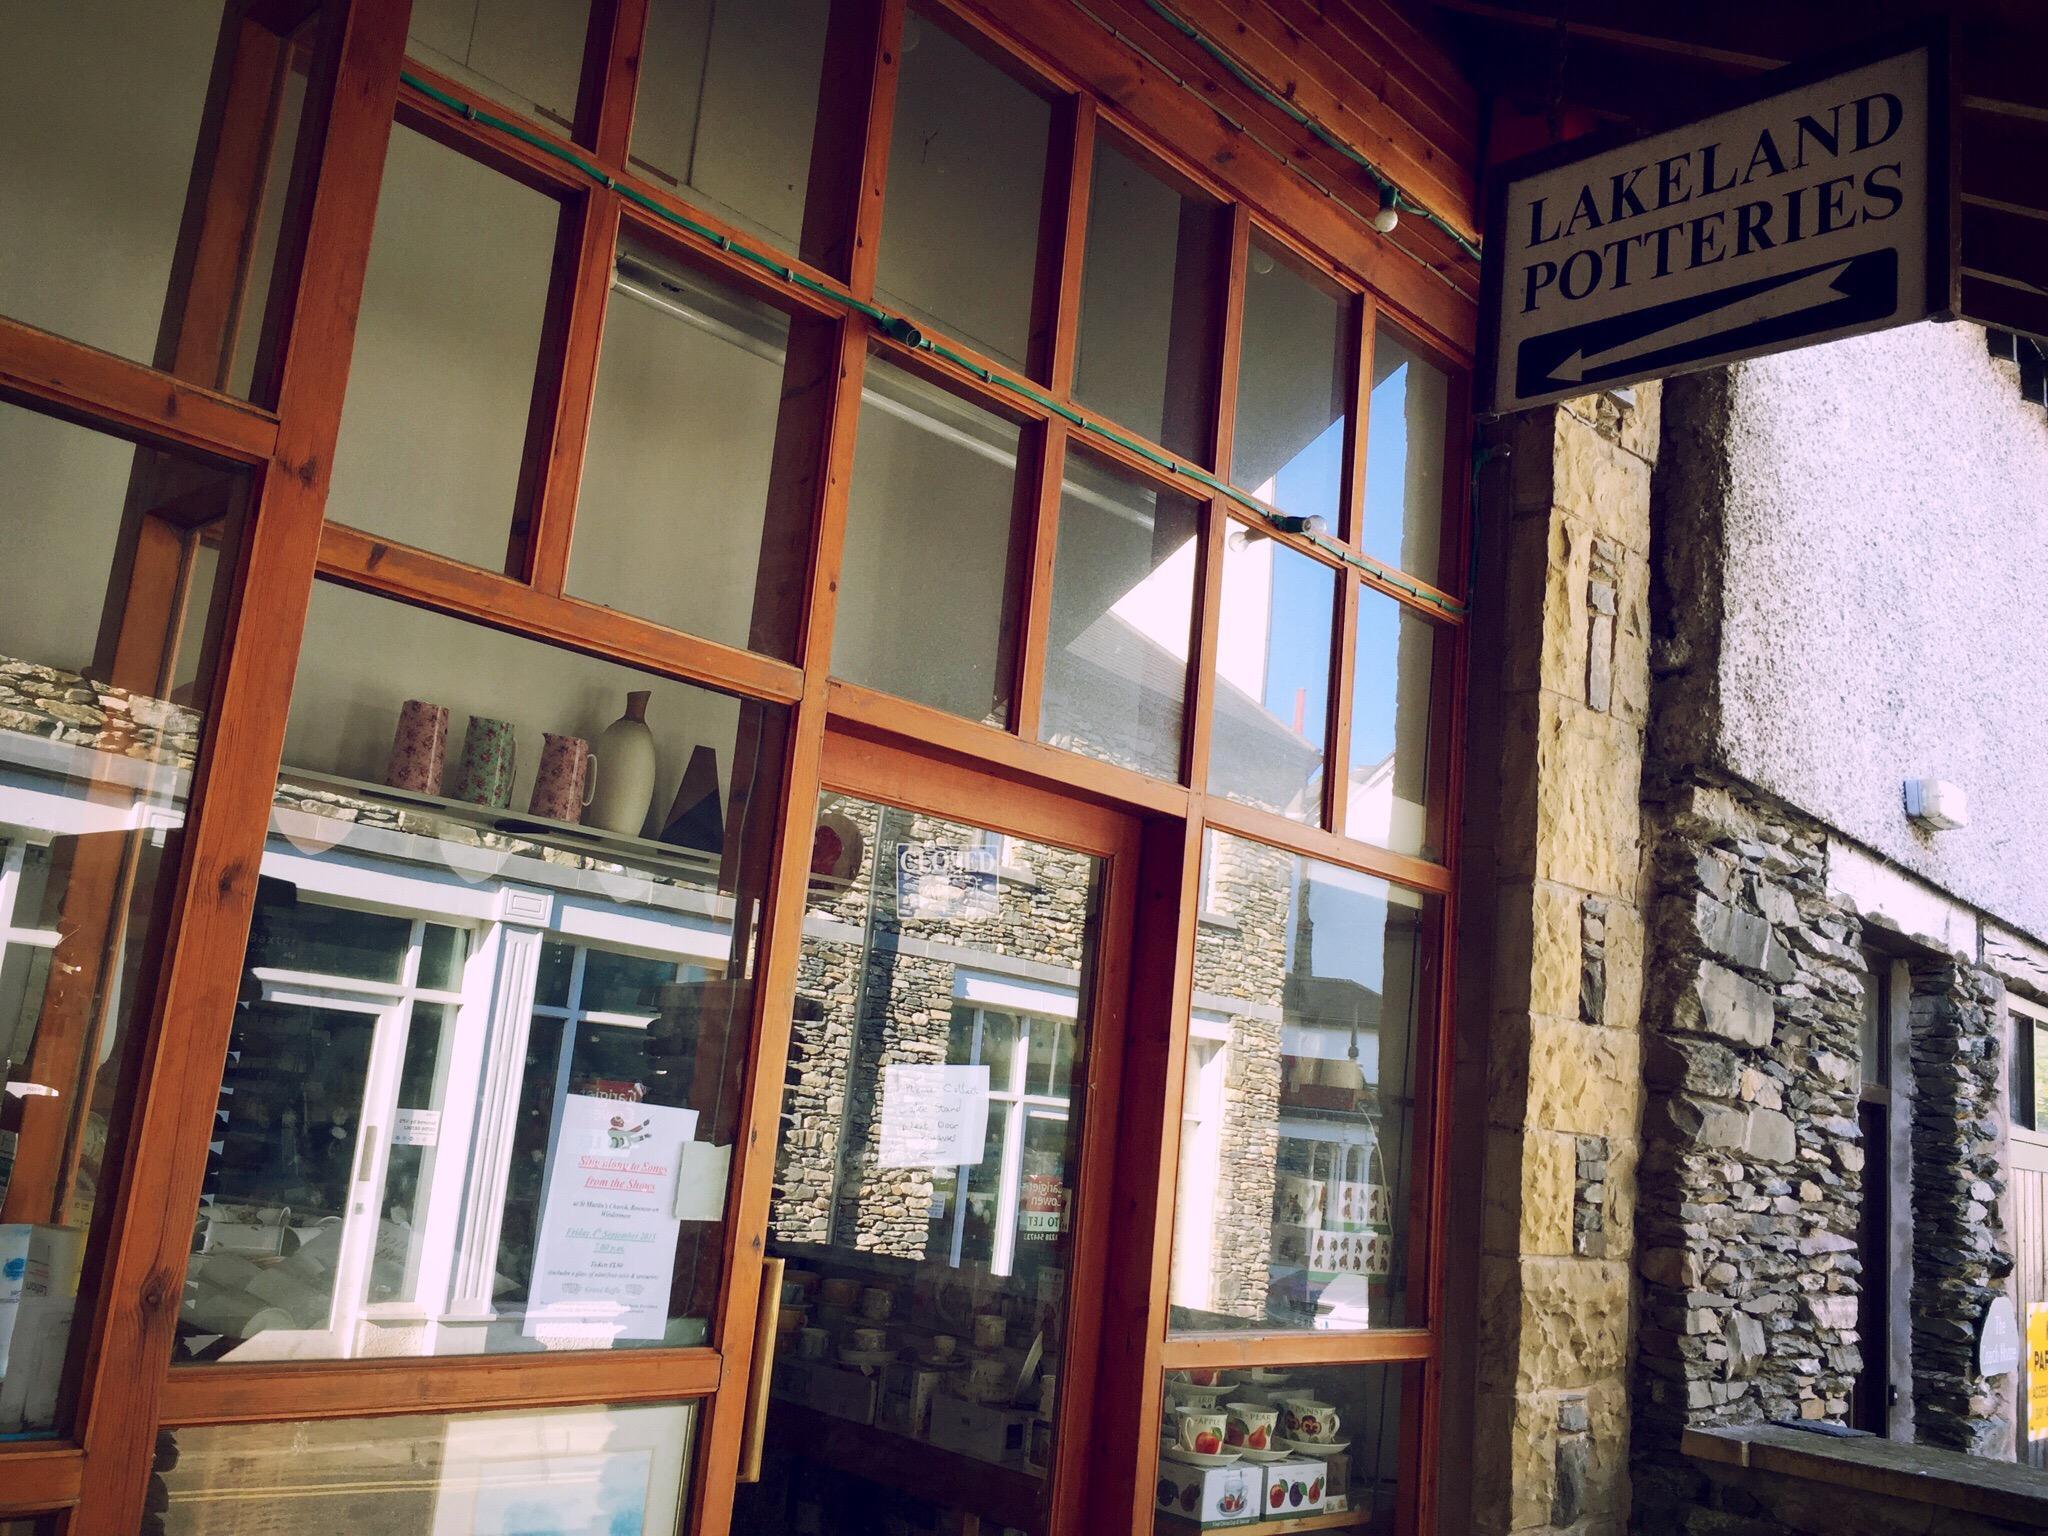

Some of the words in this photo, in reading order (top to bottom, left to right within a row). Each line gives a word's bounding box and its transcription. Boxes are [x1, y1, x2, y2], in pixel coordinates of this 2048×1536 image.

[1519, 161, 1904, 315] POTTERIES
[1524, 91, 1904, 250] LAKELAND
[584, 1175, 609, 1188] from
[610, 1177, 626, 1189] the
